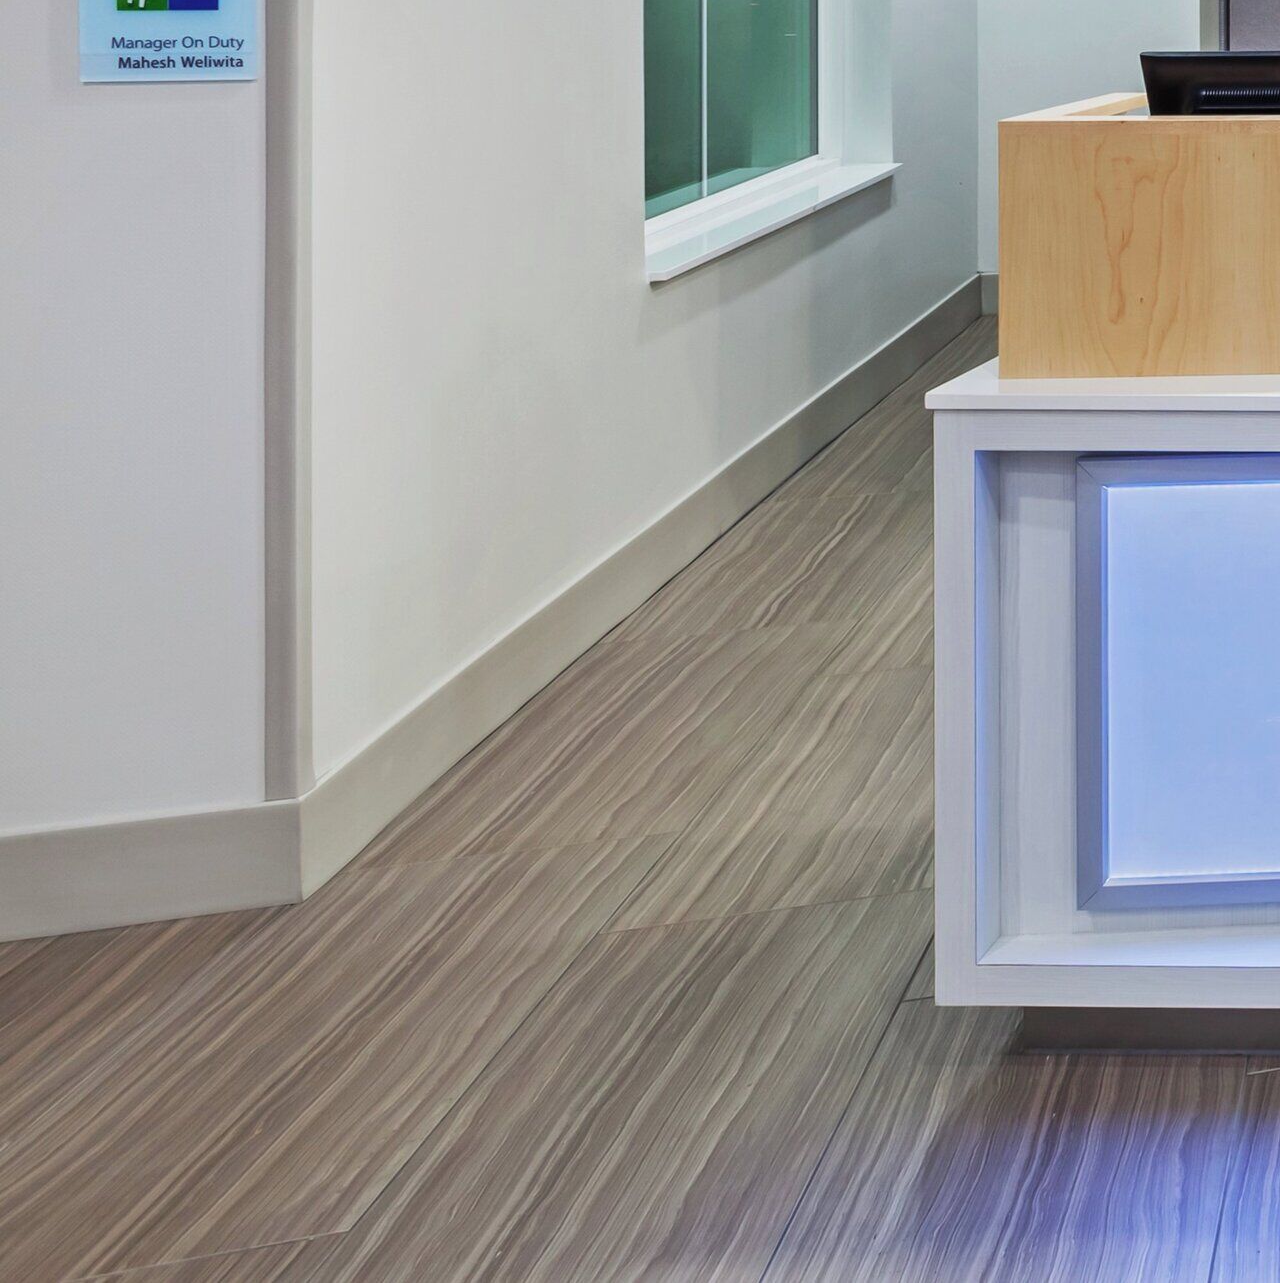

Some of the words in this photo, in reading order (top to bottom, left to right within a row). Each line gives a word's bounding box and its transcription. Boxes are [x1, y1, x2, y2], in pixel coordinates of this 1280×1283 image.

[111, 37, 178, 52] Manager
[182, 36, 204, 48] On
[208, 36, 244, 50] Duty
[118, 56, 176, 69] Mahesh
[180, 56, 244, 68] Weliwita
